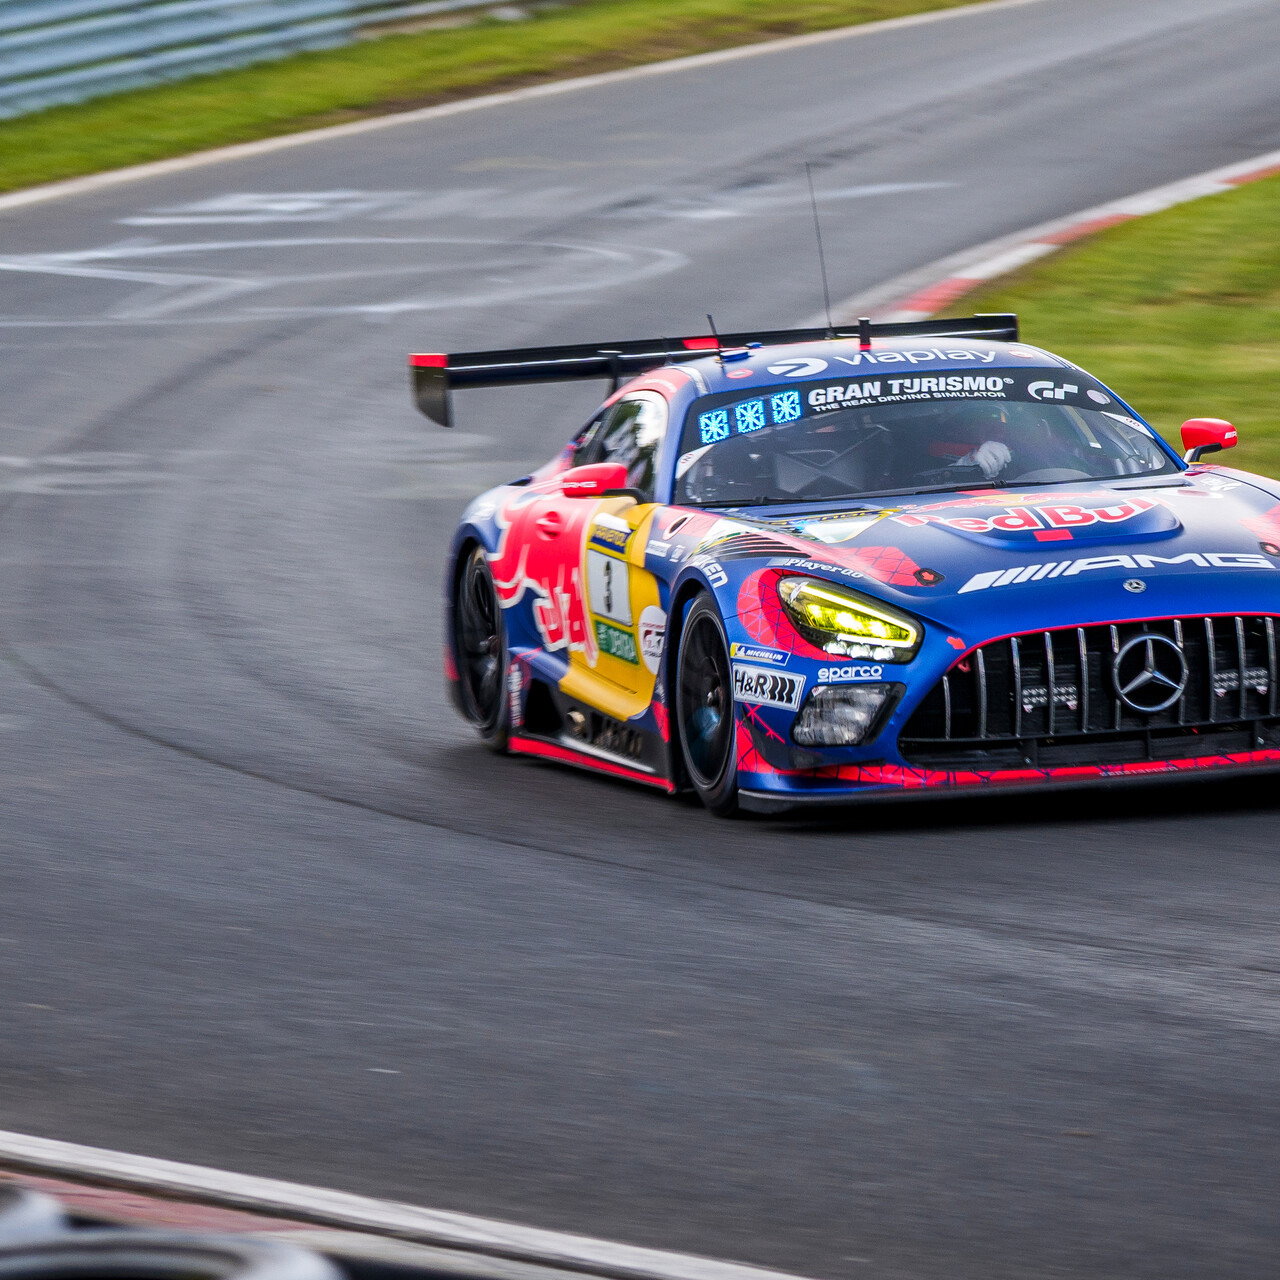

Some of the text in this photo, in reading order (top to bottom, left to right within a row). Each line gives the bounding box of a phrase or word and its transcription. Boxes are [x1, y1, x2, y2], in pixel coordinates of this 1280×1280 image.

[833, 347, 997, 365] viaplay
[808, 381, 881, 406] GRAN
[812, 391, 1006, 412] THE REAL DRIVING SIMULATOR
[746, 649, 783, 660] MICHELIN
[733, 669, 768, 697] H&R
